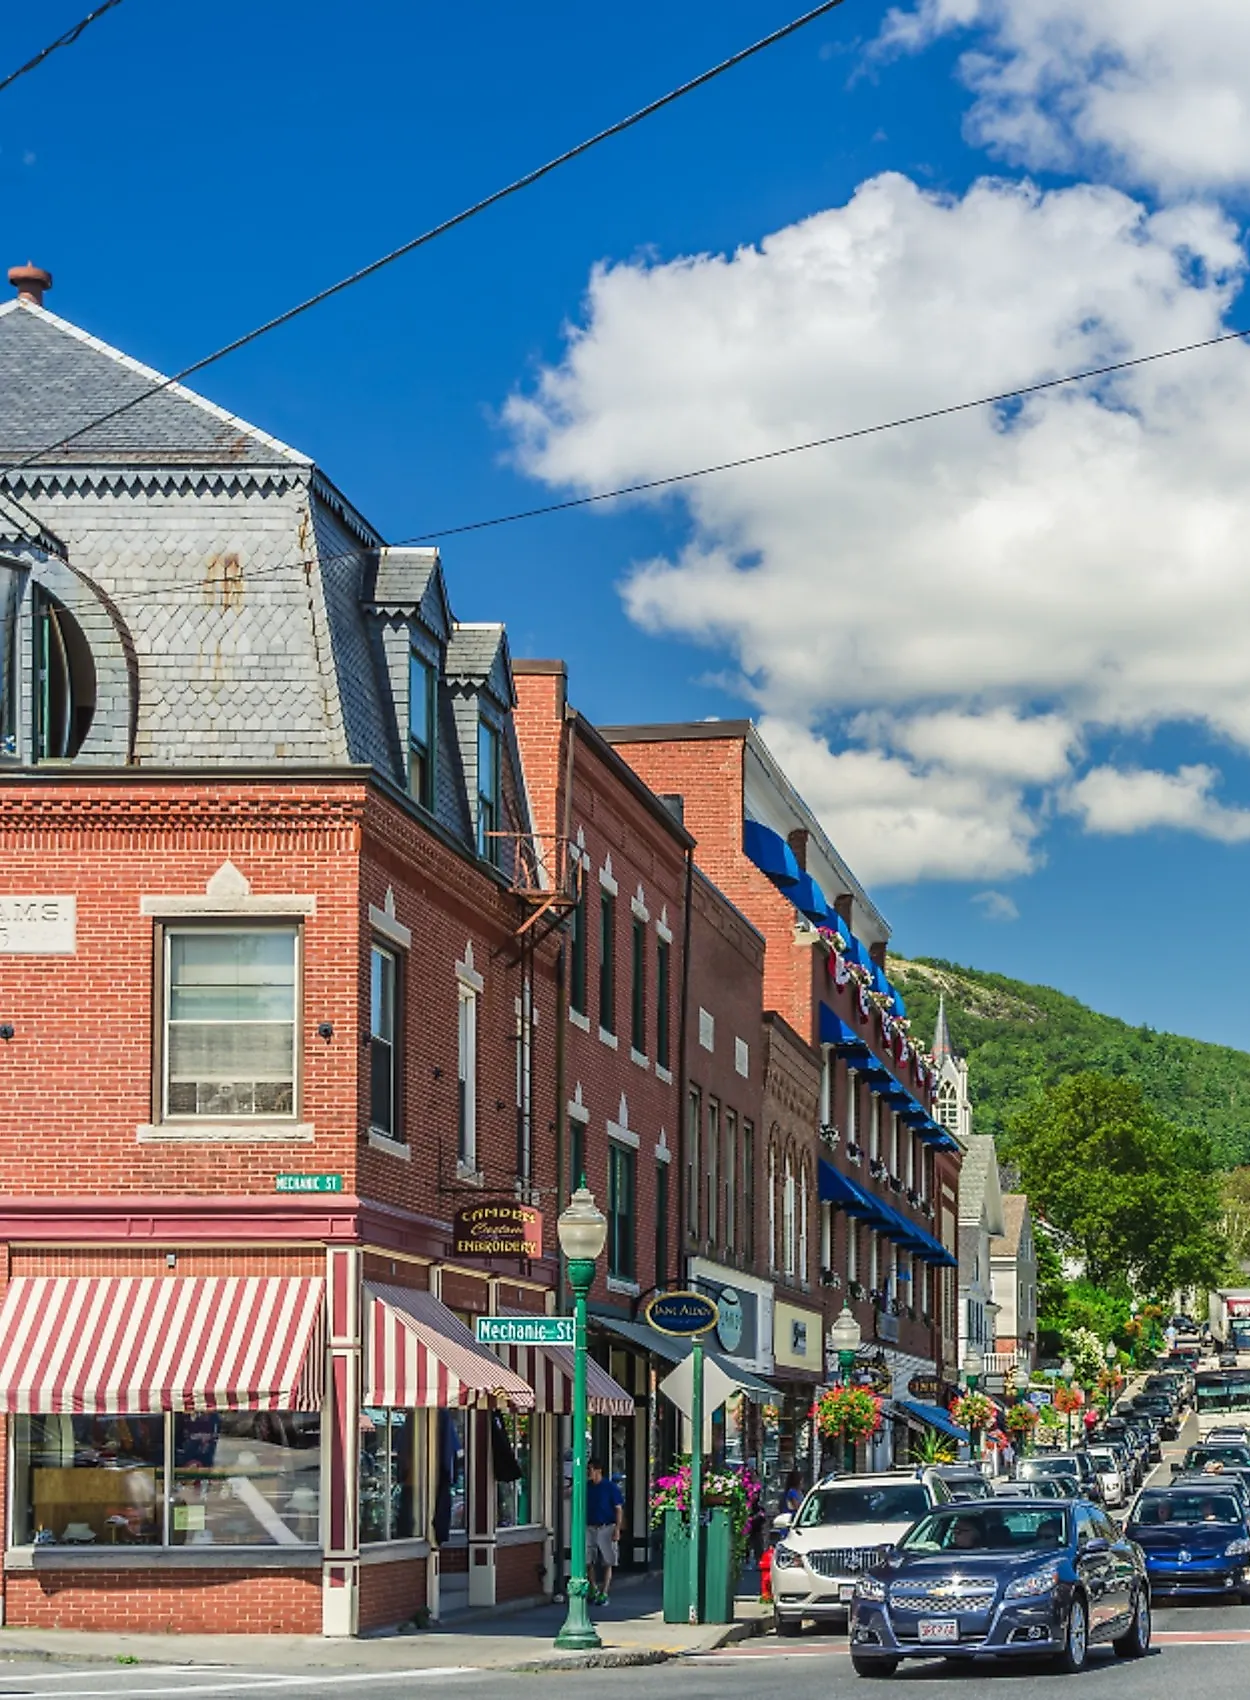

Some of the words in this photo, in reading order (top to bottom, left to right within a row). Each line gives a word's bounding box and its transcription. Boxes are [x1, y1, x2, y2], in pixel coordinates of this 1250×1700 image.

[462, 1208, 536, 1223] CAMDEN
[457, 1240, 536, 1254] EMBROIDERY
[480, 1321, 546, 1341] Mechanic
[556, 1321, 572, 1340] St
